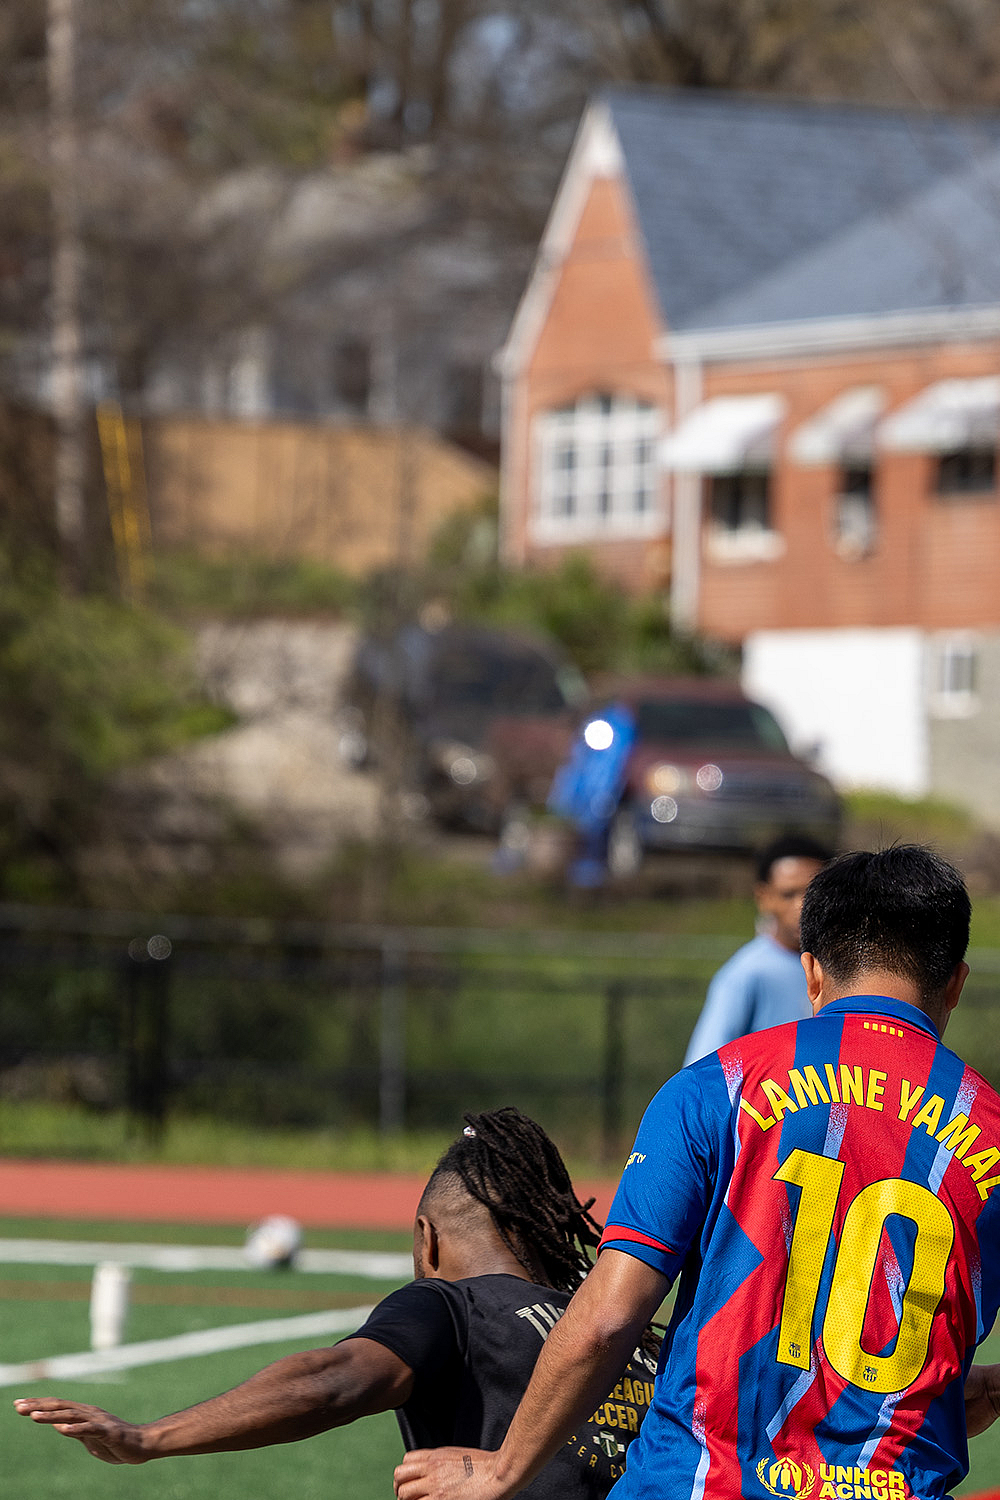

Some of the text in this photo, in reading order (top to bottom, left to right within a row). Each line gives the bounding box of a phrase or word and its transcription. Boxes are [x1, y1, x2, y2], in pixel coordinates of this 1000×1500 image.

[740, 1063, 888, 1132] LAMINE
[771, 1147, 956, 1394] 10
[608, 1377, 655, 1407] EAGU
[587, 1402, 638, 1433] CCER
[819, 1462, 905, 1490] UNHCR
